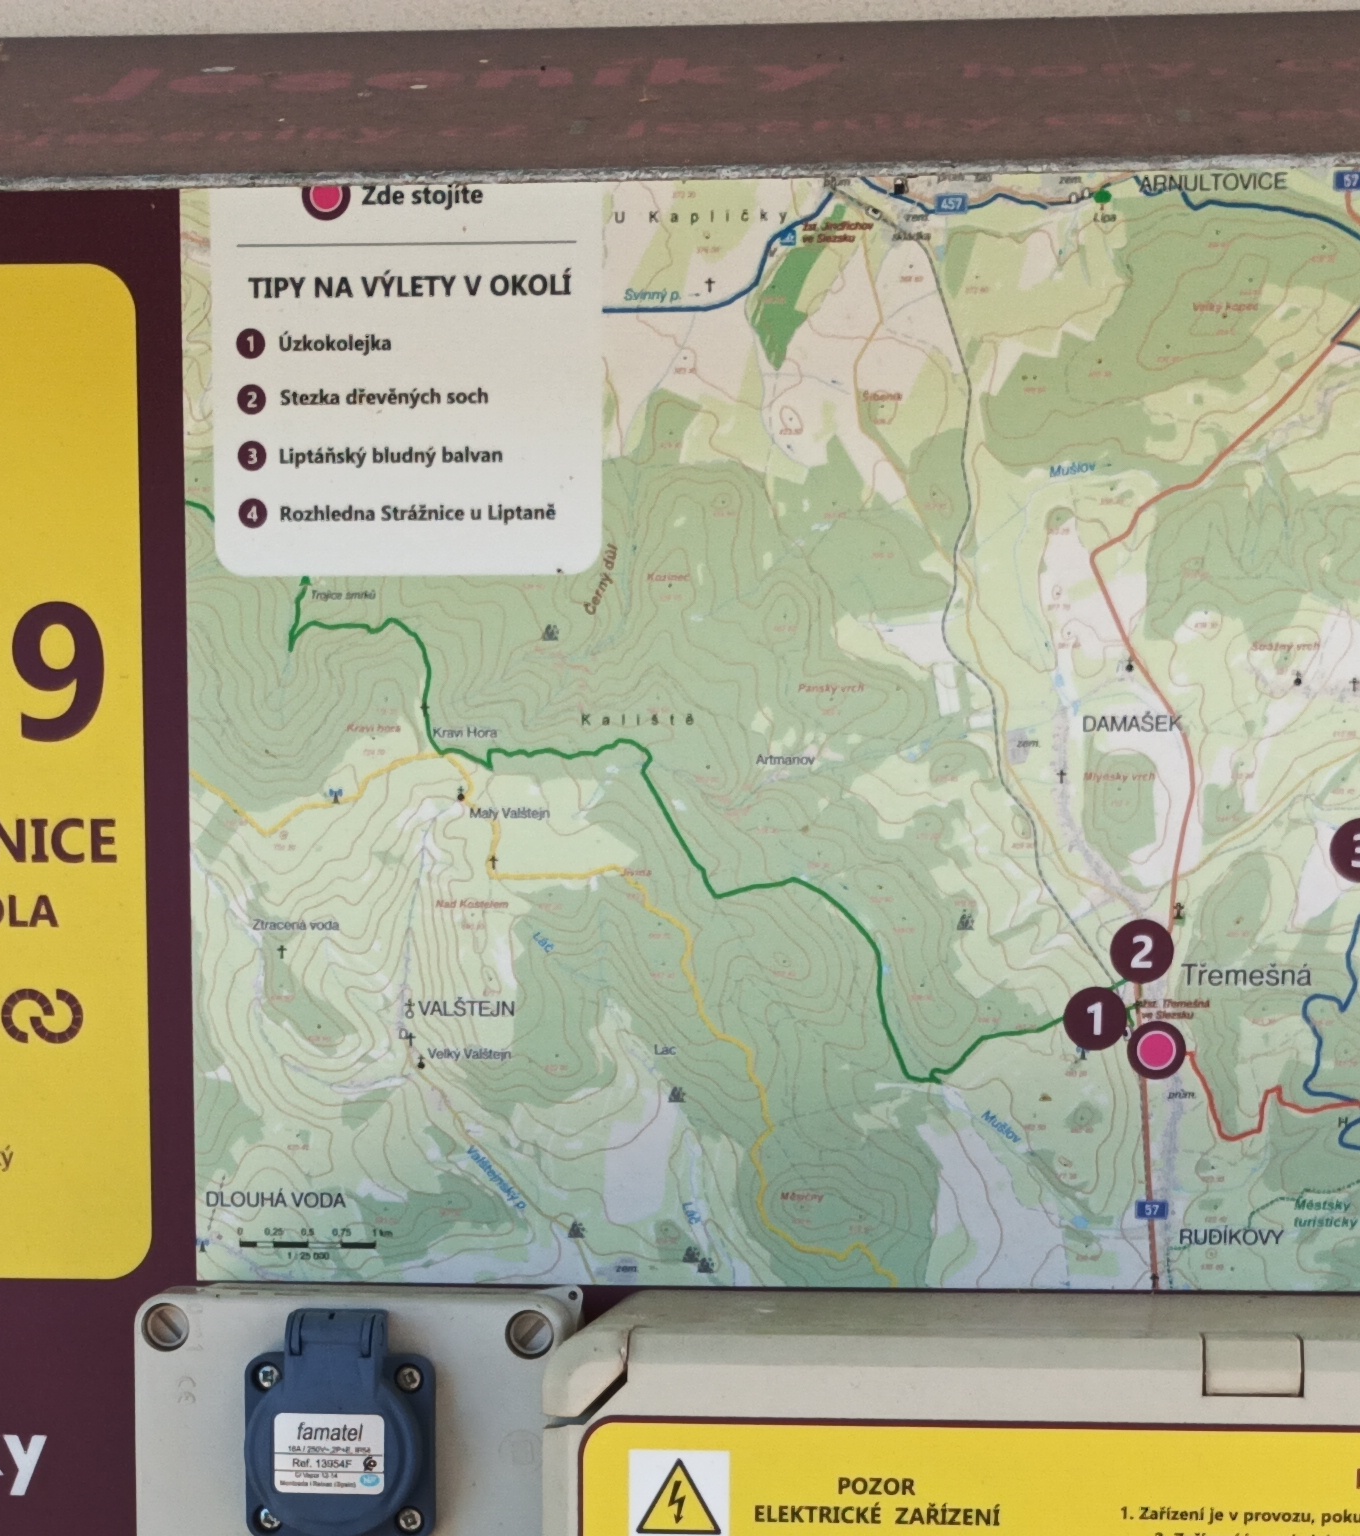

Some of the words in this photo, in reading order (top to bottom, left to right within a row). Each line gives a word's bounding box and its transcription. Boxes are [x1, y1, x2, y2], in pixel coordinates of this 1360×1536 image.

[1138, 171, 1288, 192] ARNULTOVICE
[1343, 175, 1360, 188] 57
[361, 184, 405, 205] Zde
[411, 184, 483, 211] stojíte
[941, 198, 964, 212] 457
[248, 277, 305, 298] TIPY
[314, 277, 353, 298] NA
[361, 270, 456, 298] VÝLETY
[463, 275, 482, 297] V
[489, 268, 572, 297] OKOLÍ
[278, 331, 392, 357] Úzkokolejka
[280, 389, 340, 406] Stezka
[345, 387, 442, 410] dřevěných
[446, 387, 489, 405] soch
[279, 446, 367, 469] Liptáňský
[372, 446, 437, 469] bludný
[441, 446, 503, 464] balvan
[279, 505, 376, 522] Rozhledna
[380, 504, 465, 522] Strážnice
[470, 509, 482, 521] u
[487, 503, 557, 525] Liptaně
[1081, 711, 1183, 733] DAMAŠEK
[1130, 934, 1154, 969] 2
[1181, 961, 1312, 989] Třemešná
[418, 997, 515, 1018] VALŠTEJN
[1086, 1001, 1103, 1036] 1
[205, 1186, 287, 1209] DLOUHÁ
[291, 1191, 346, 1209] VODA
[1144, 1204, 1160, 1217] 57
[1179, 1225, 1284, 1247] RUDÍKOVY
[296, 1421, 364, 1442] famatel
[837, 1476, 916, 1496] POZOR
[754, 1501, 882, 1525] ELEKTRICKÉ
[894, 1502, 1000, 1527] ZAŘÍZENÍ
[1120, 1506, 1134, 1521] 1.
[1138, 1506, 1205, 1522] Zařízení
[1208, 1507, 1224, 1525] je
[1228, 1510, 1239, 1522] v
[1243, 1510, 1315, 1527] provozu,
